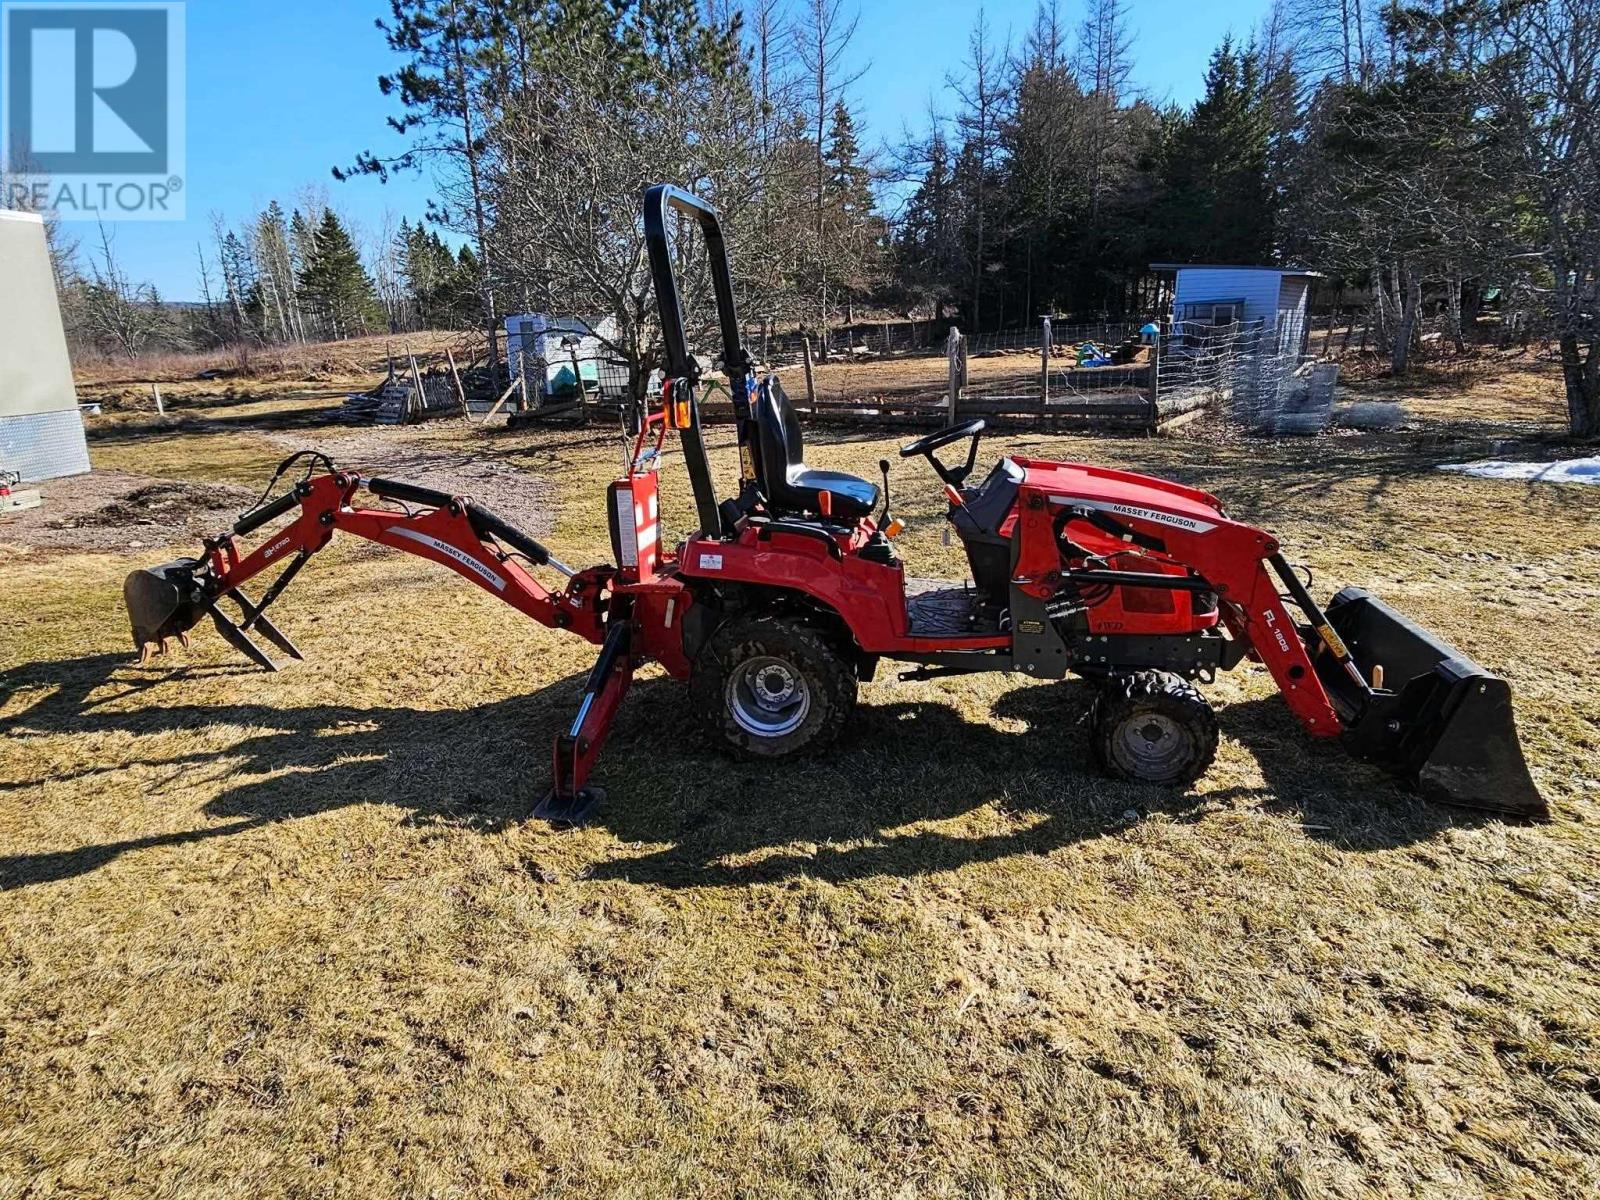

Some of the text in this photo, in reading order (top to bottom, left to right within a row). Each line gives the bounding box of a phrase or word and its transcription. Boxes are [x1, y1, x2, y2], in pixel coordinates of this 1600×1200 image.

[1113, 505, 1196, 528] MASSEY FERGUSON
[433, 541, 497, 582] MASSEY FERGUSON
[1263, 609, 1276, 628] FL
